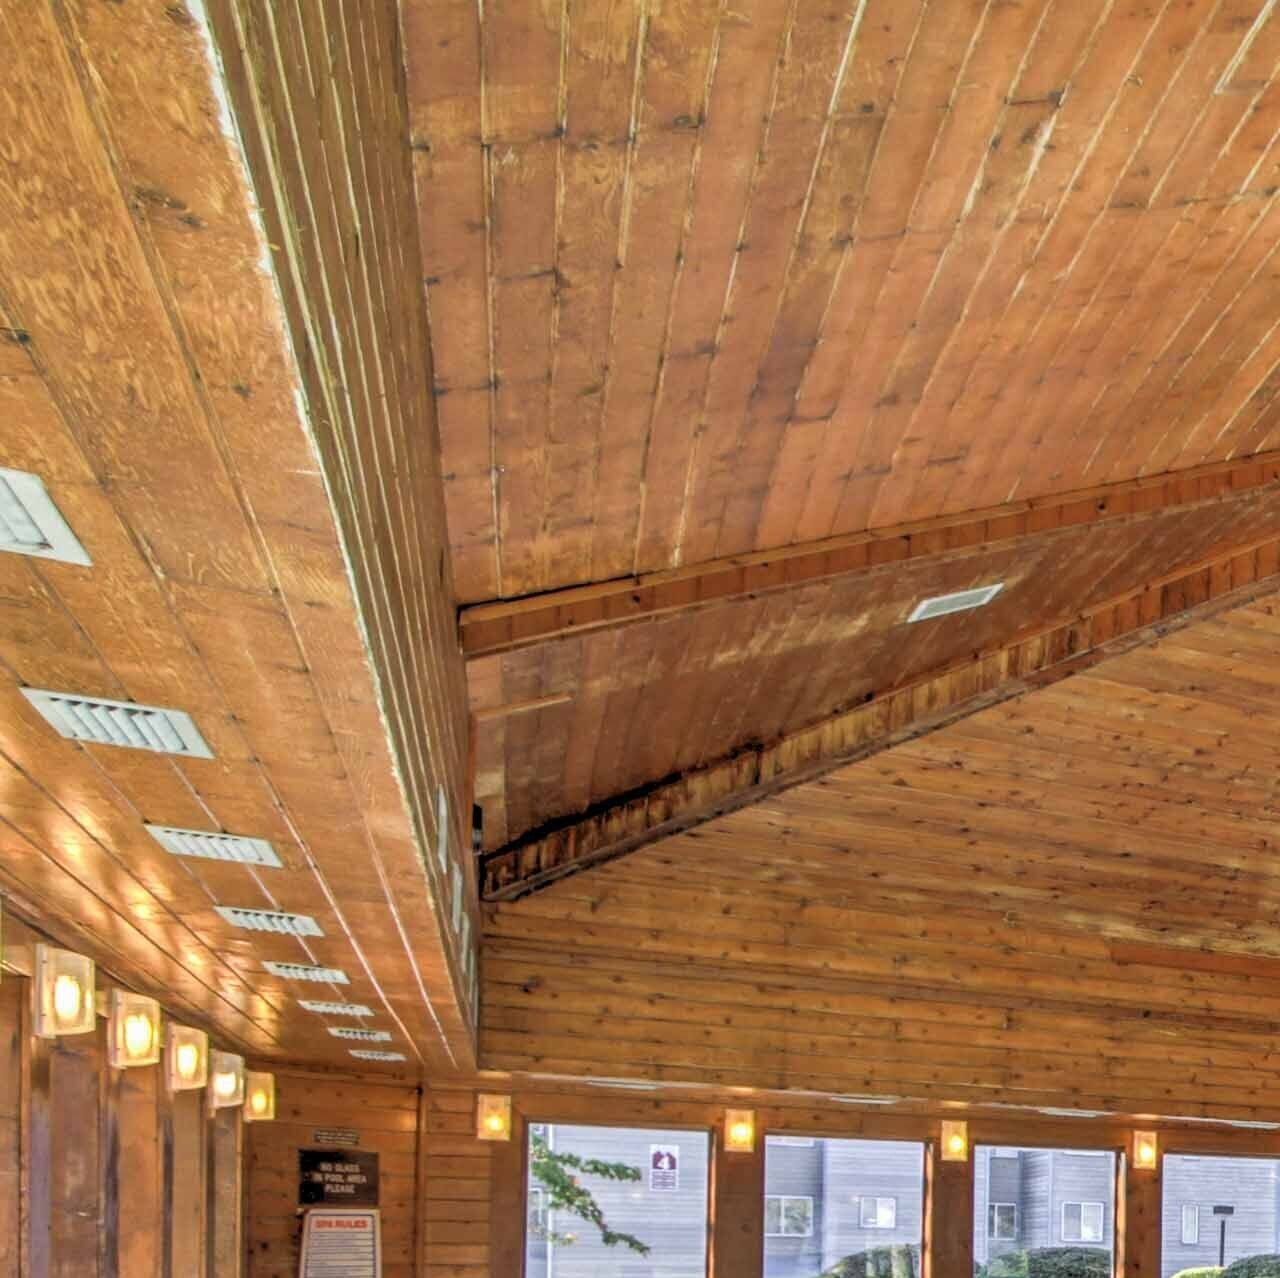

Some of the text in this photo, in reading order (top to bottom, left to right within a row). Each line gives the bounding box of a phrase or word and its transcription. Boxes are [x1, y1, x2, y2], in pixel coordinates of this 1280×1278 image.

[320, 1163, 332, 1172] NO
[325, 1173, 344, 1183] POOL
[347, 1174, 367, 1184] AREA
[325, 1184, 355, 1193] PLEASE
